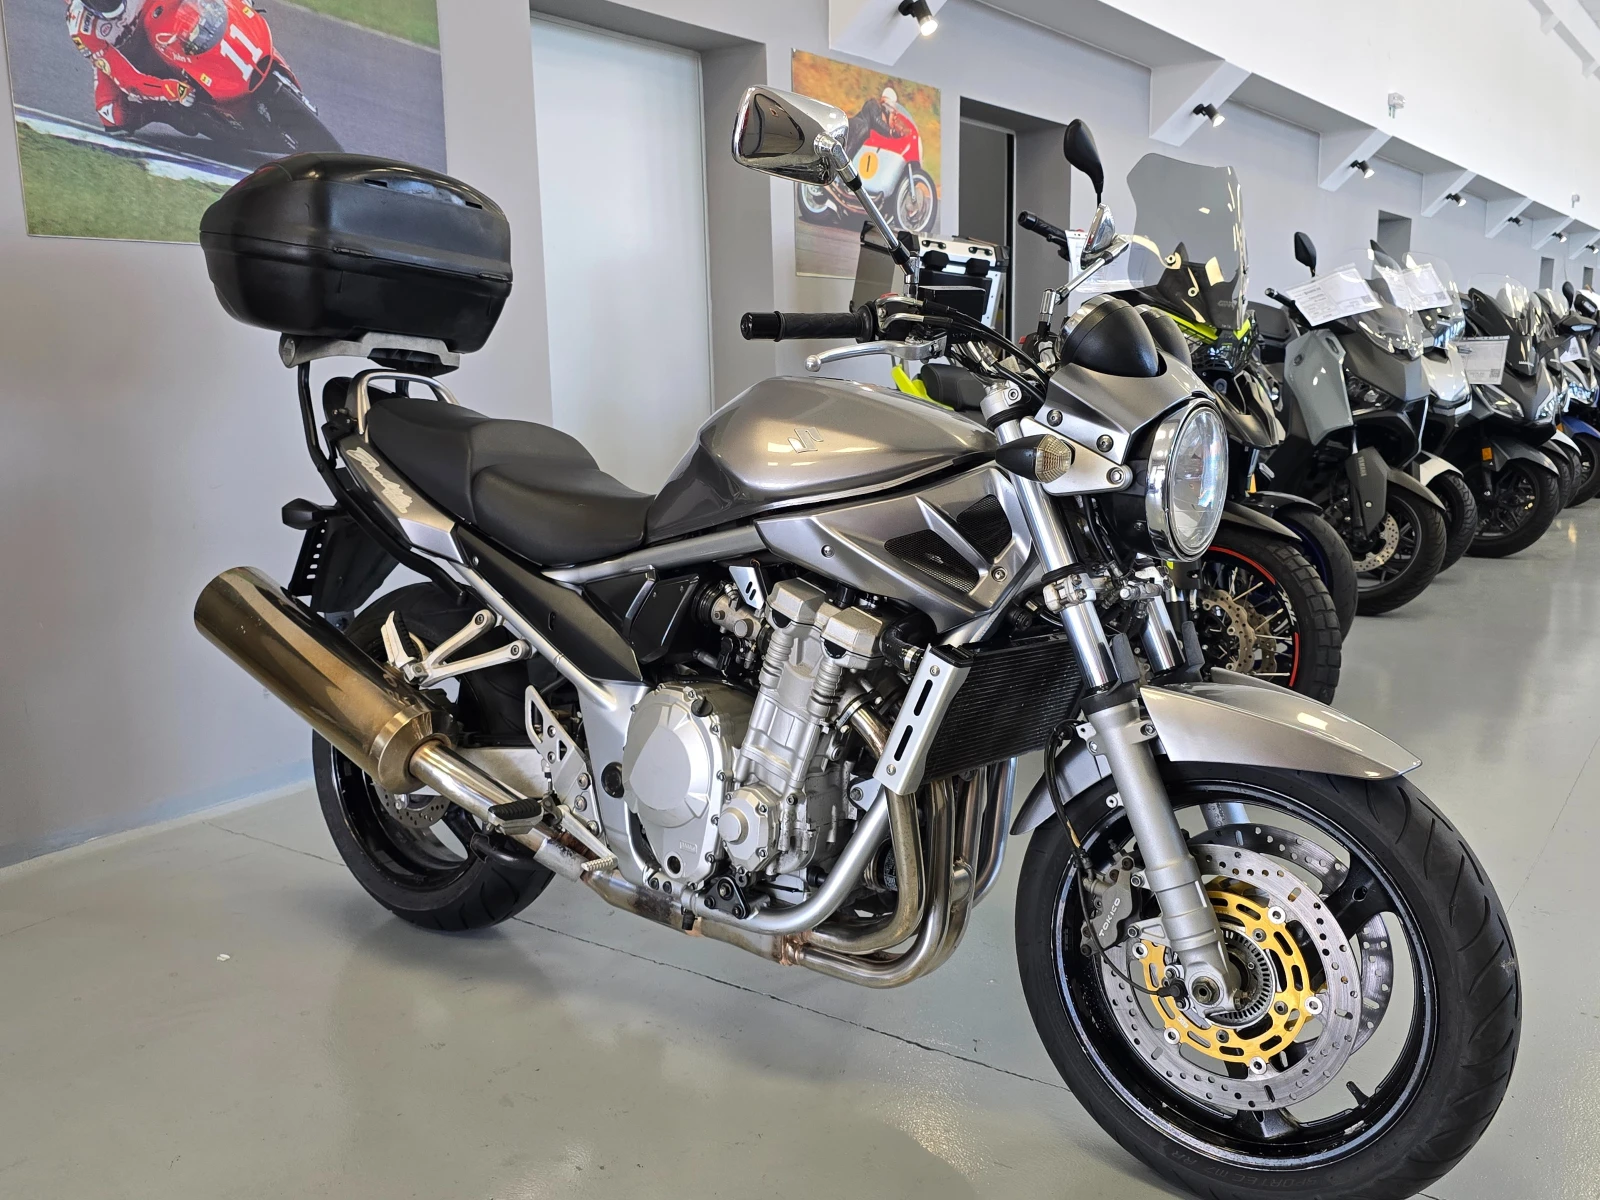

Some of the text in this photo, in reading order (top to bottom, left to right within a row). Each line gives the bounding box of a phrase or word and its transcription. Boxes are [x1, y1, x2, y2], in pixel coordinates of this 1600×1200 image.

[220, 24, 263, 82] 11
[866, 155, 871, 172] 1
[1357, 456, 1367, 477] YAMAHA
[1099, 898, 1121, 936] TOKICO
[1171, 1152, 1198, 1165] RR
[1232, 1174, 1318, 1188] SPORTEC
